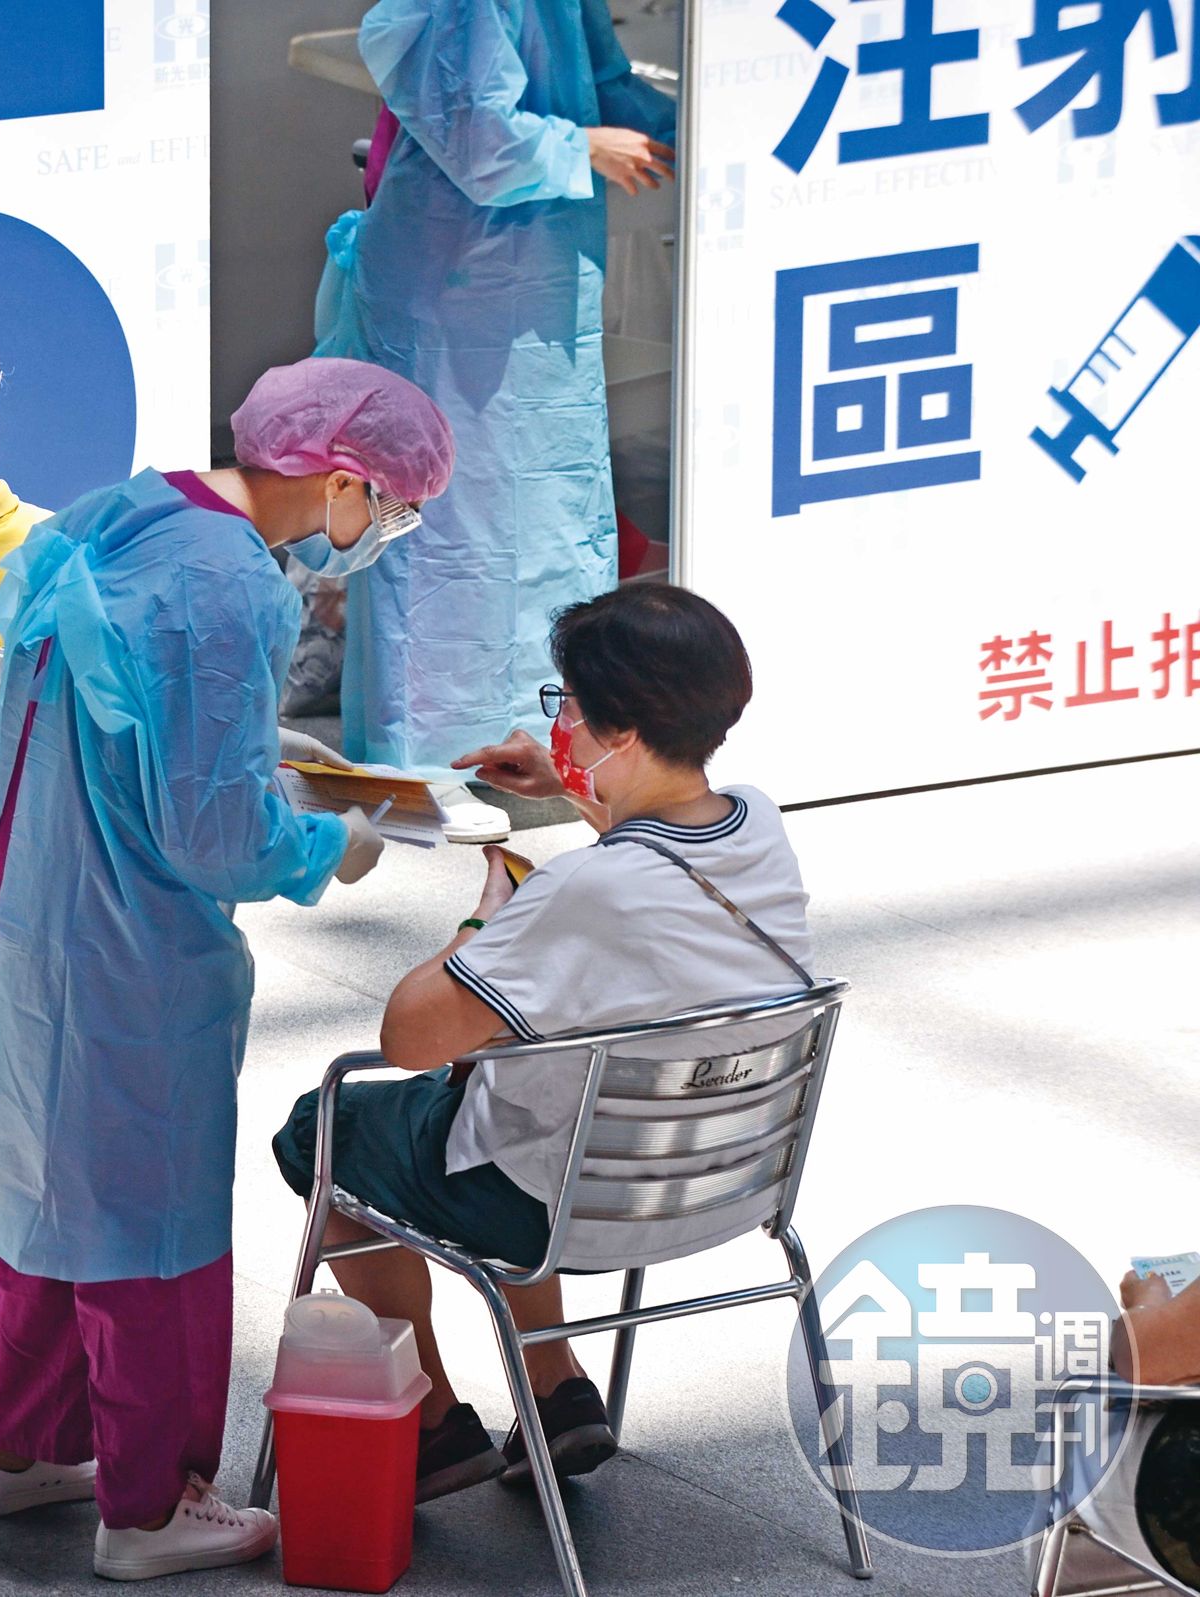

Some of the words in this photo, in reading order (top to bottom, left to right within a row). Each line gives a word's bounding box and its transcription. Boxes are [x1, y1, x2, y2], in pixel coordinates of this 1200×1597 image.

[36, 144, 110, 176] SAFE
[771, 242, 982, 518] 區
[681, 1059, 752, 1089] Leader
